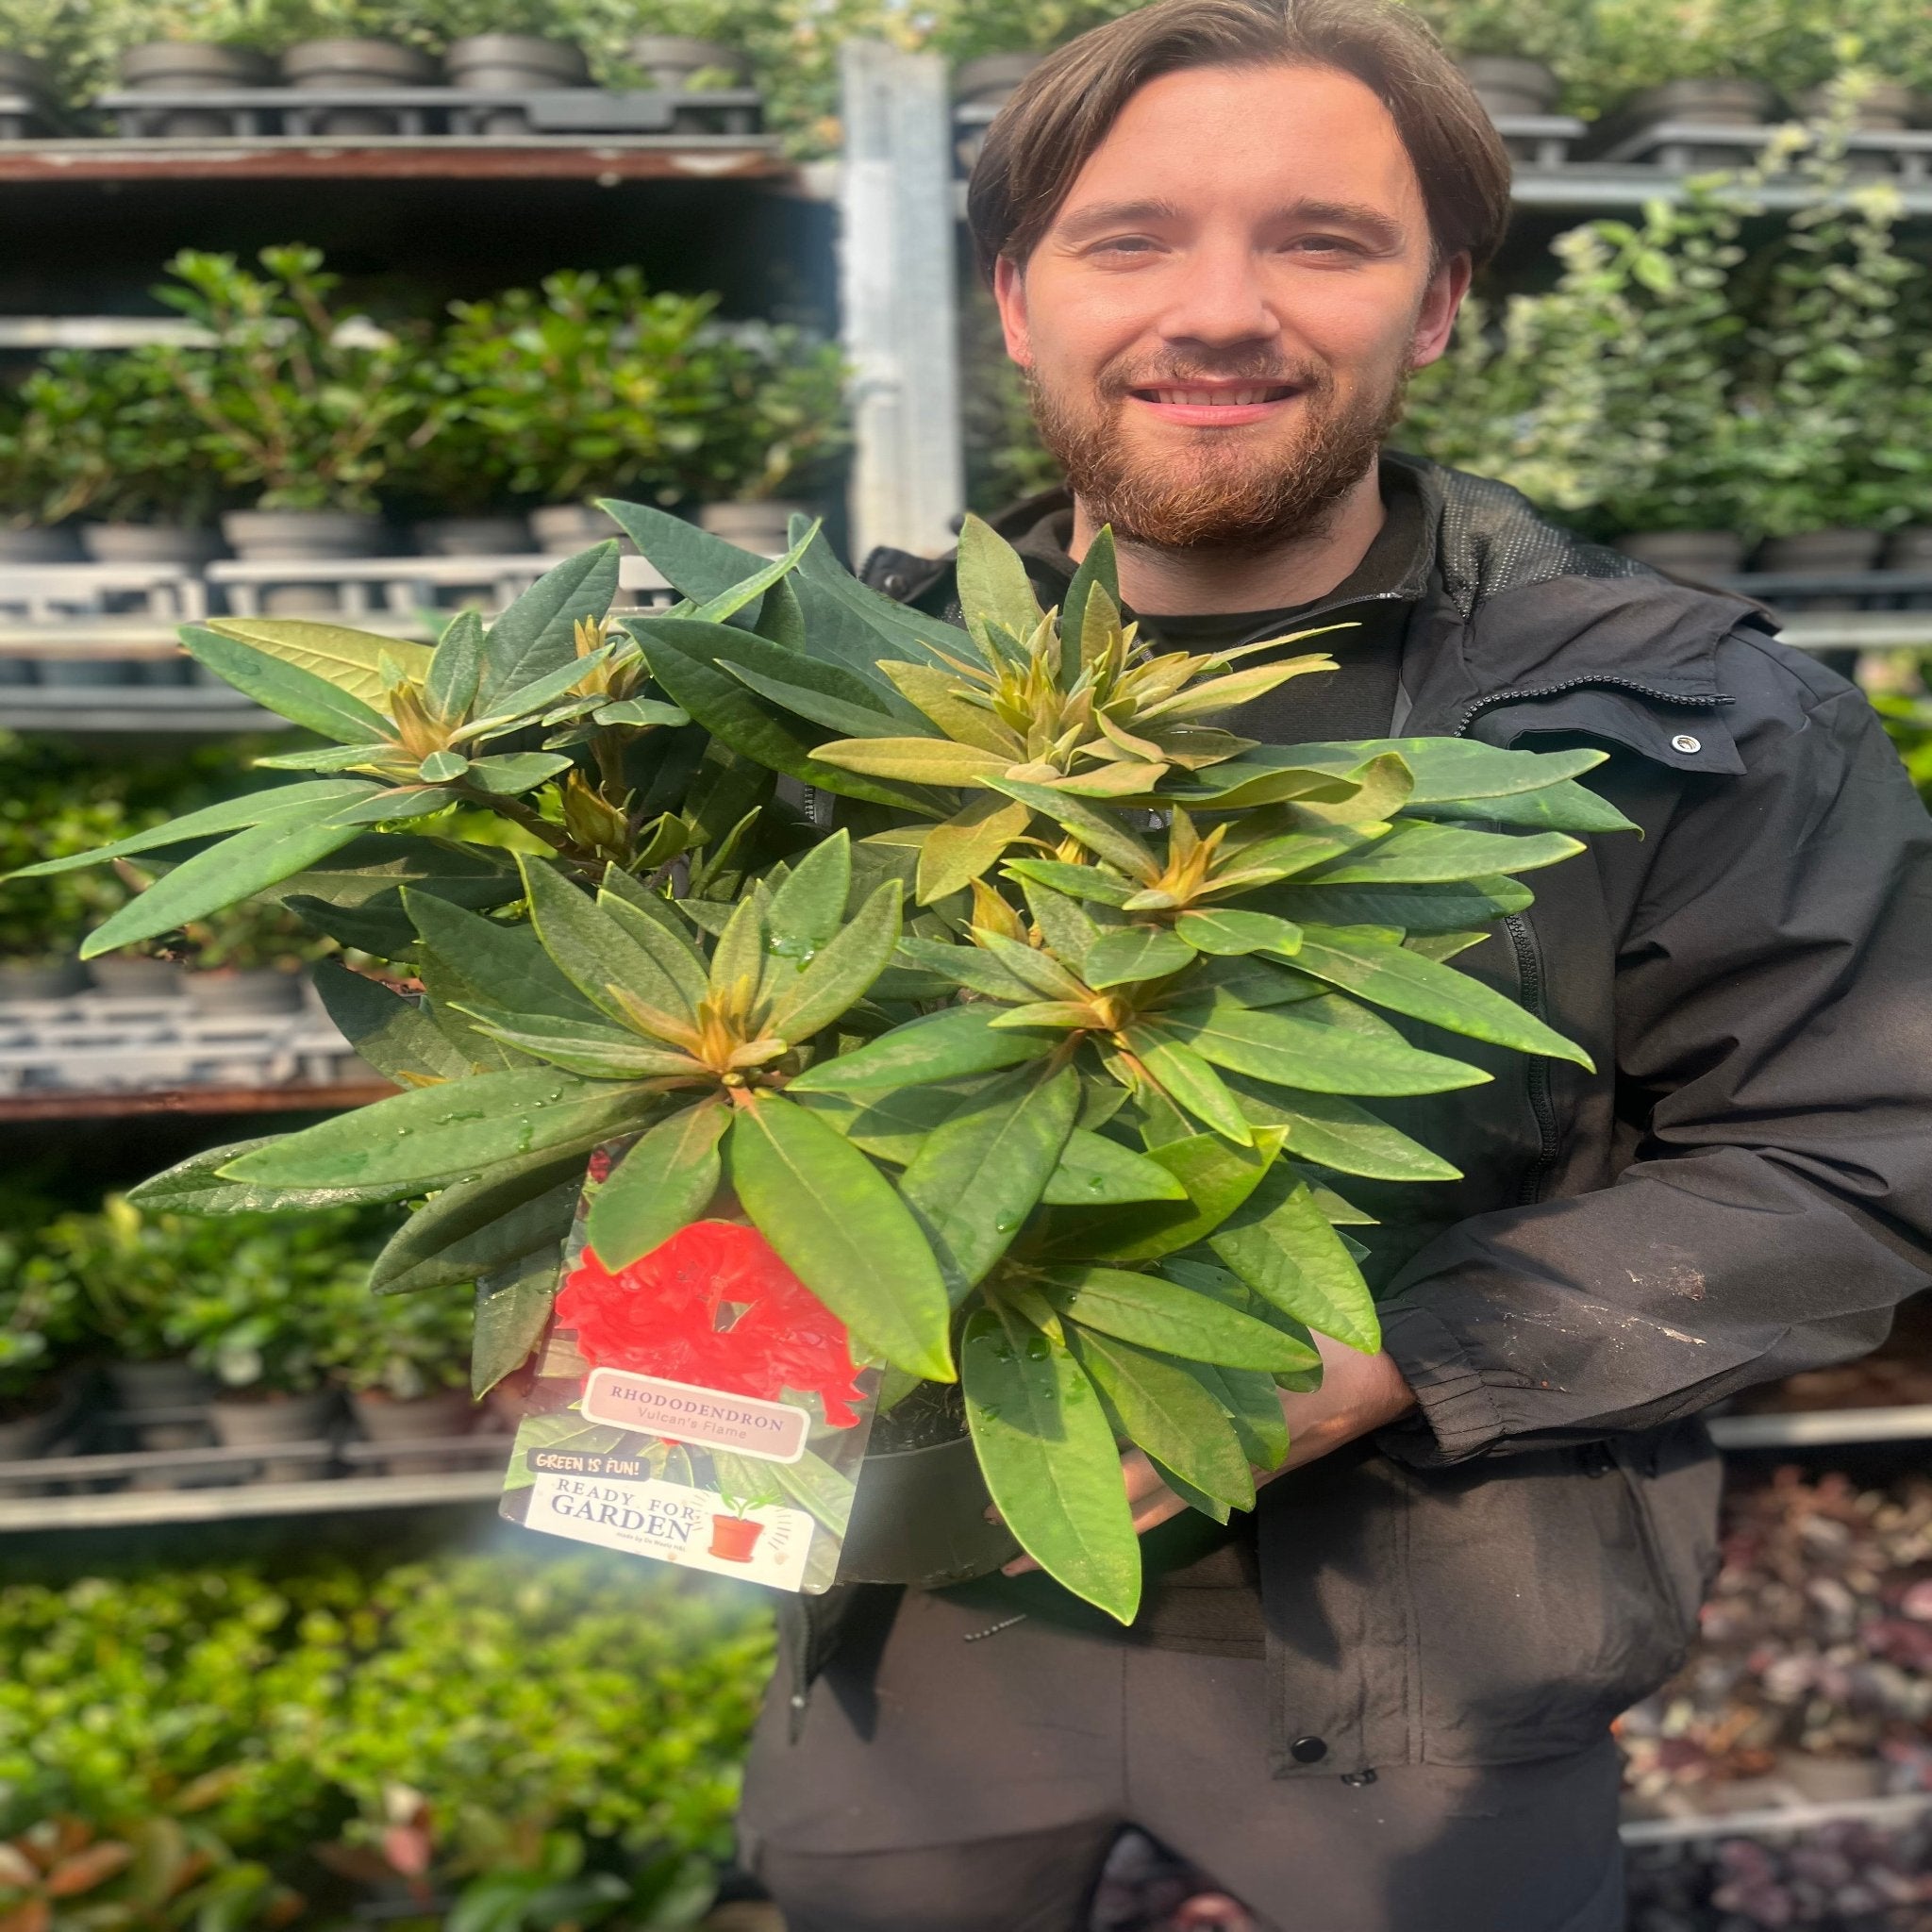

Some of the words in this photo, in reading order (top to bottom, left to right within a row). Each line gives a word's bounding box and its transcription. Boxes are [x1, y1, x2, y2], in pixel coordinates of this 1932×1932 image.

[610, 1385, 784, 1432] RHODODENDRON
[638, 1407, 697, 1428] Vulcan's
[703, 1422, 747, 1439] Flame
[536, 1454, 583, 1472] GREEN
[588, 1458, 601, 1473] IS
[606, 1458, 640, 1475] FUN!
[551, 1494, 693, 1542] GARDEN
[557, 1478, 636, 1506] READY
[648, 1499, 696, 1520] FOR
